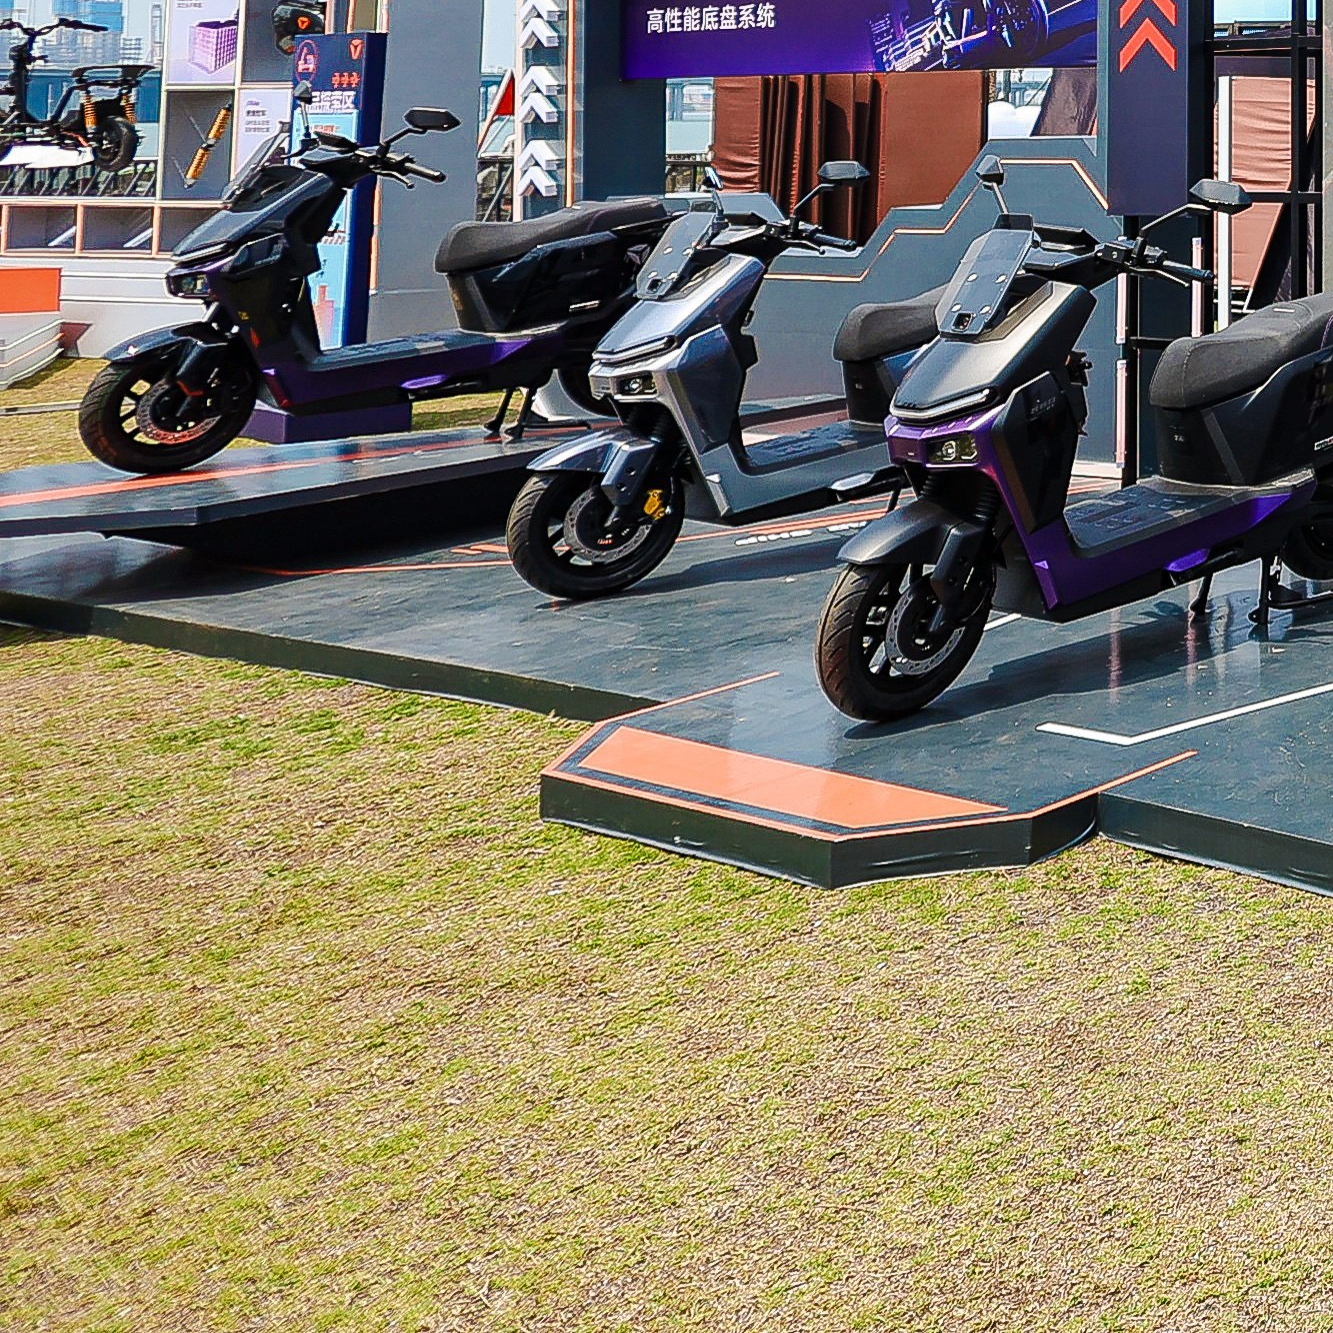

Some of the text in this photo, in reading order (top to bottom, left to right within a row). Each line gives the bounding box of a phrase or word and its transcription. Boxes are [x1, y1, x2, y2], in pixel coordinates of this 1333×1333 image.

[646, 2, 776, 34] 高性能底盘系统
